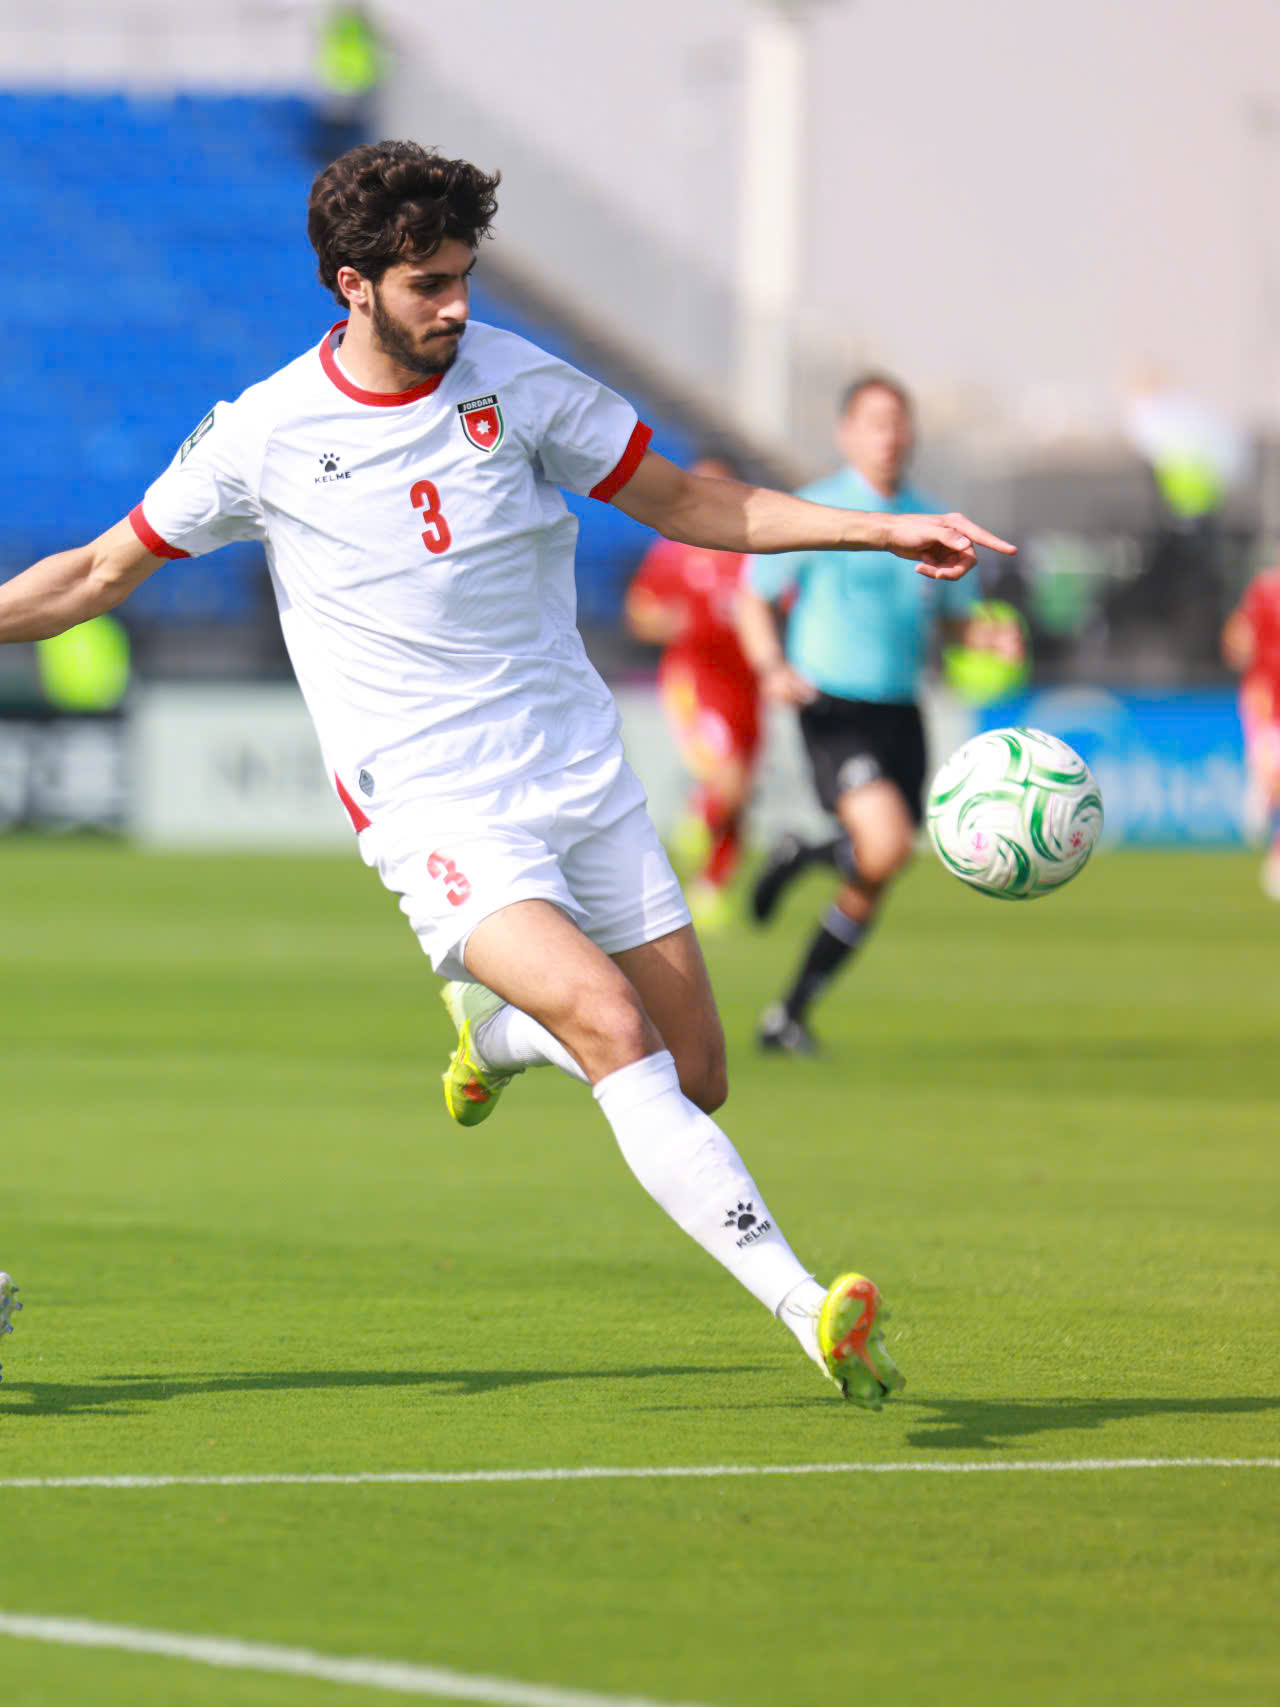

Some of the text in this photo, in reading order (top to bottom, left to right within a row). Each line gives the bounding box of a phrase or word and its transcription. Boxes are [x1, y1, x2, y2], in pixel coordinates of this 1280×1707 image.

[463, 397, 494, 411] JORDAN
[315, 471, 352, 484] KELME
[411, 480, 451, 554] 3
[427, 850, 471, 906] 3
